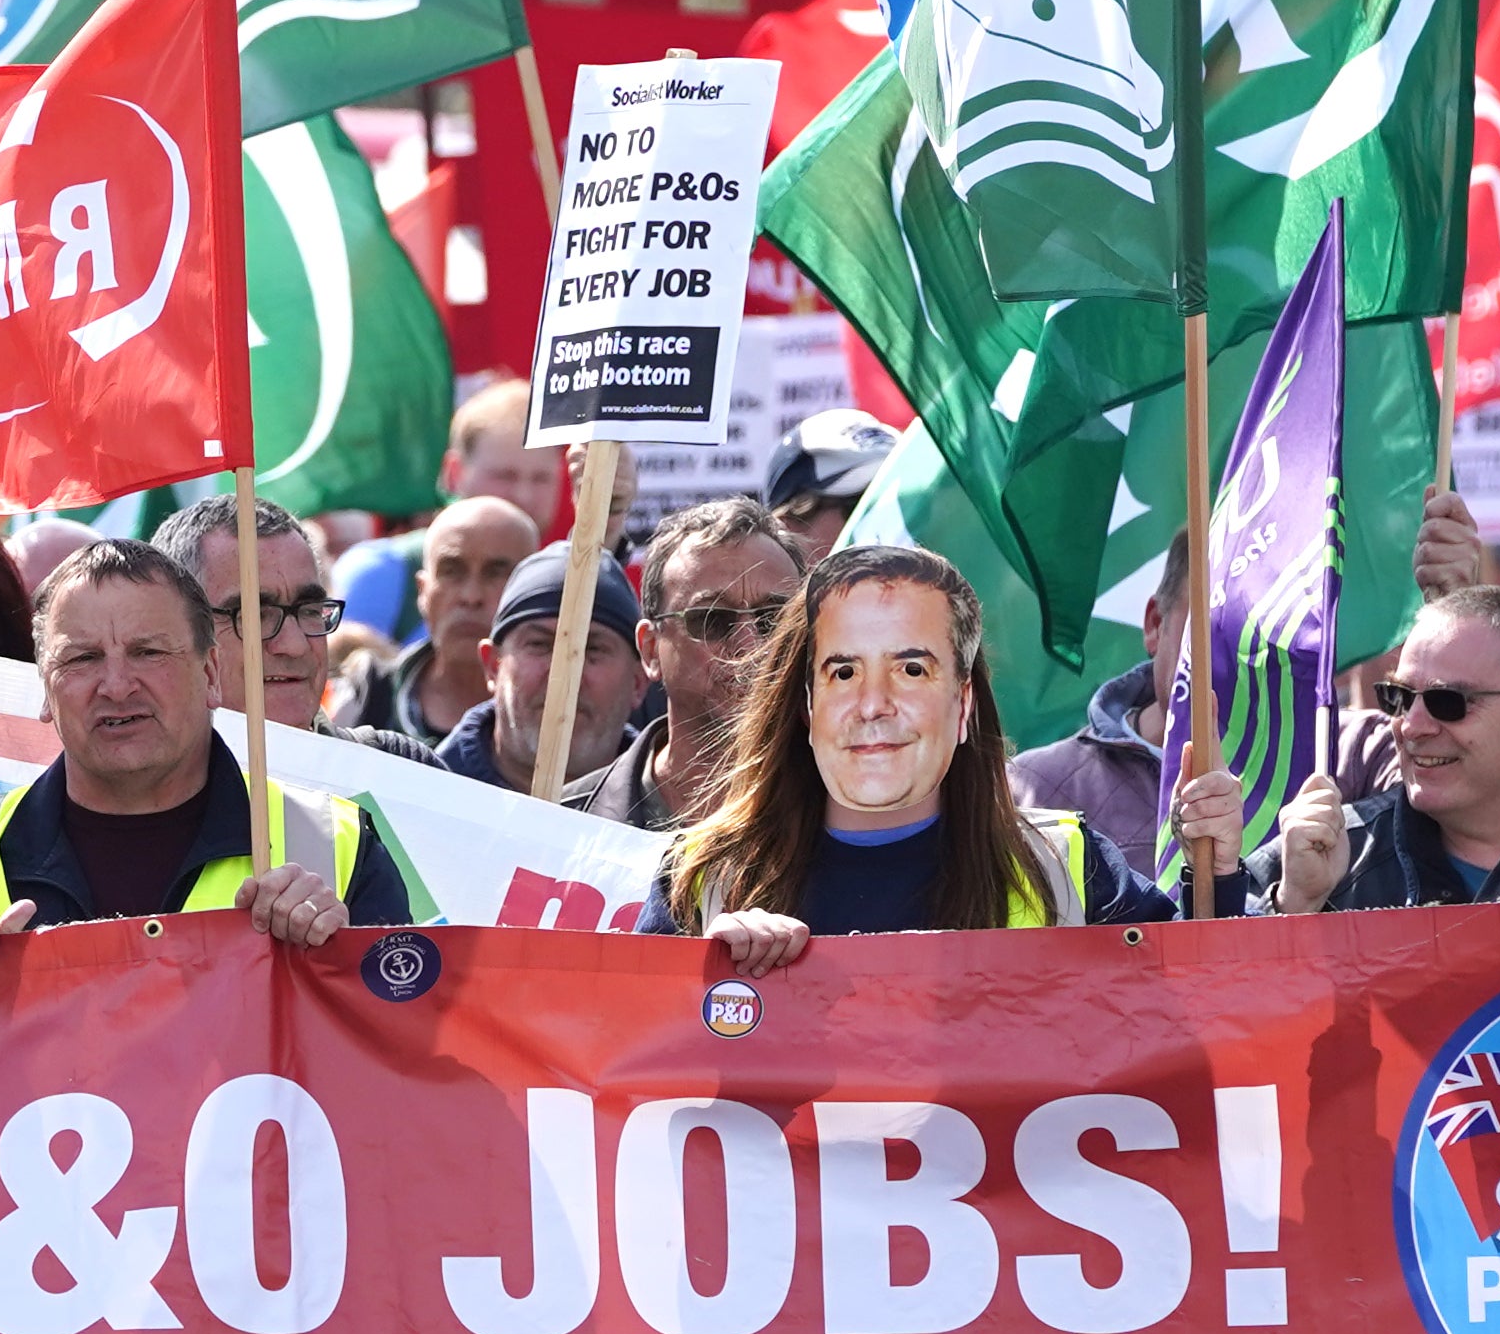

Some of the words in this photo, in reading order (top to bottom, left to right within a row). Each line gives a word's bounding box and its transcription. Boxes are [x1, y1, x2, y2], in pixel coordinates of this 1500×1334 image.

[579, 131, 618, 163] NO
[627, 125, 655, 157] TO
[572, 173, 644, 210] MORE
[649, 171, 740, 201] P&Os
[565, 221, 637, 260] FIGHT
[642, 220, 712, 250] FOR
[557, 268, 641, 308] EVERY
[647, 268, 712, 298] JOB
[553, 339, 593, 368] Stop
[593, 330, 633, 359] this
[637, 334, 692, 355] race
[549, 371, 570, 395] to
[572, 366, 600, 392] the
[601, 361, 691, 386] bottom
[709, 1002, 755, 1025] P&O
